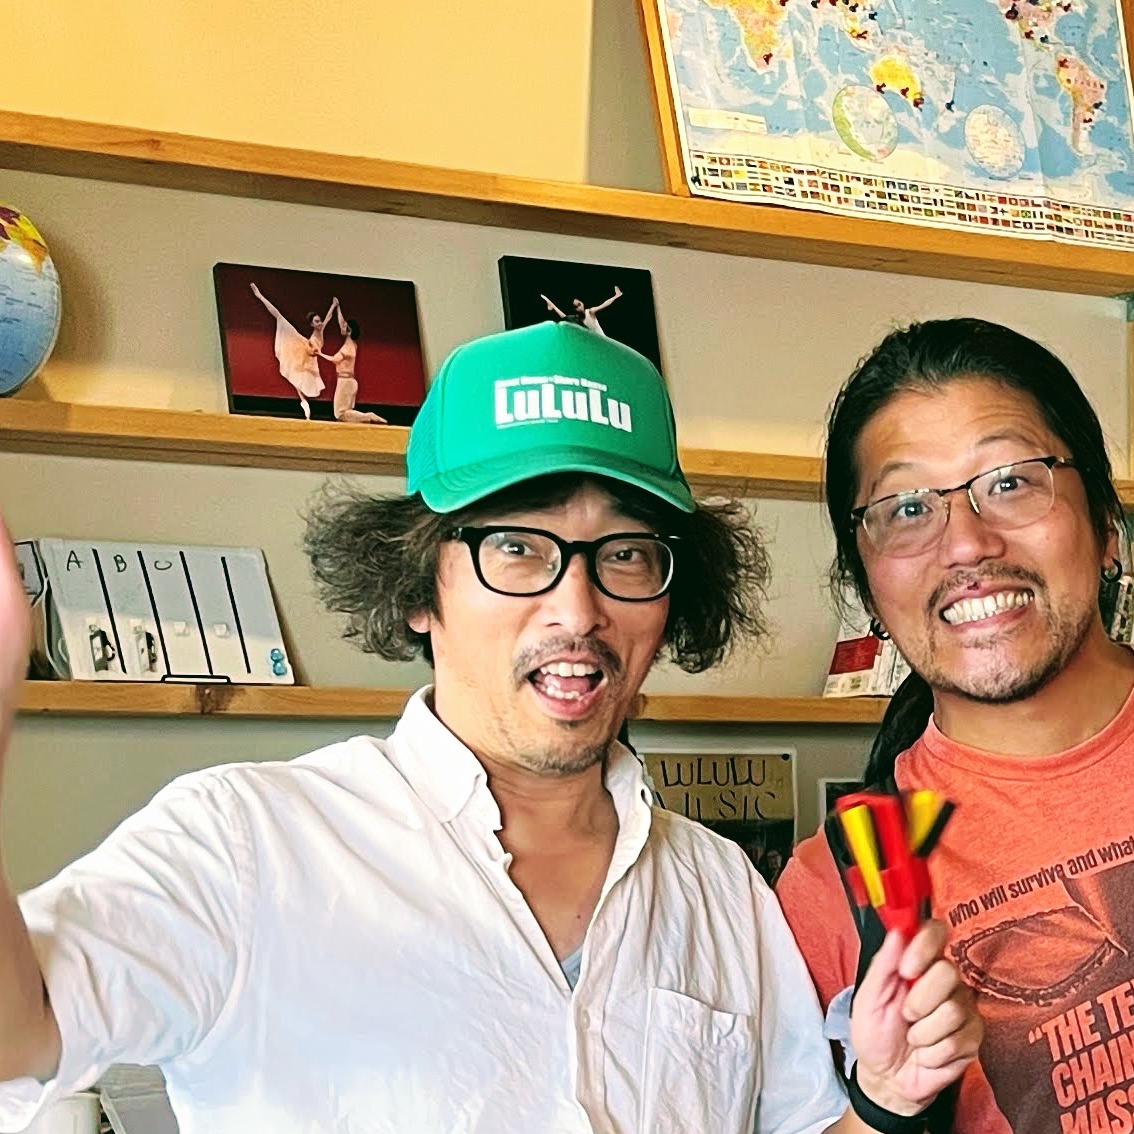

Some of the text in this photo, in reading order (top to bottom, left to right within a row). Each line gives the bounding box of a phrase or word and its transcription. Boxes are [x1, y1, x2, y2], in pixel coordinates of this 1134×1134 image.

[494, 383, 632, 433] LuLuLu
[65, 549, 84, 572] A
[113, 554, 128, 573] B
[660, 756, 767, 788] LULULU
[978, 884, 1009, 911] will
[1007, 863, 1067, 900] survive
[1066, 848, 1099, 876] and
